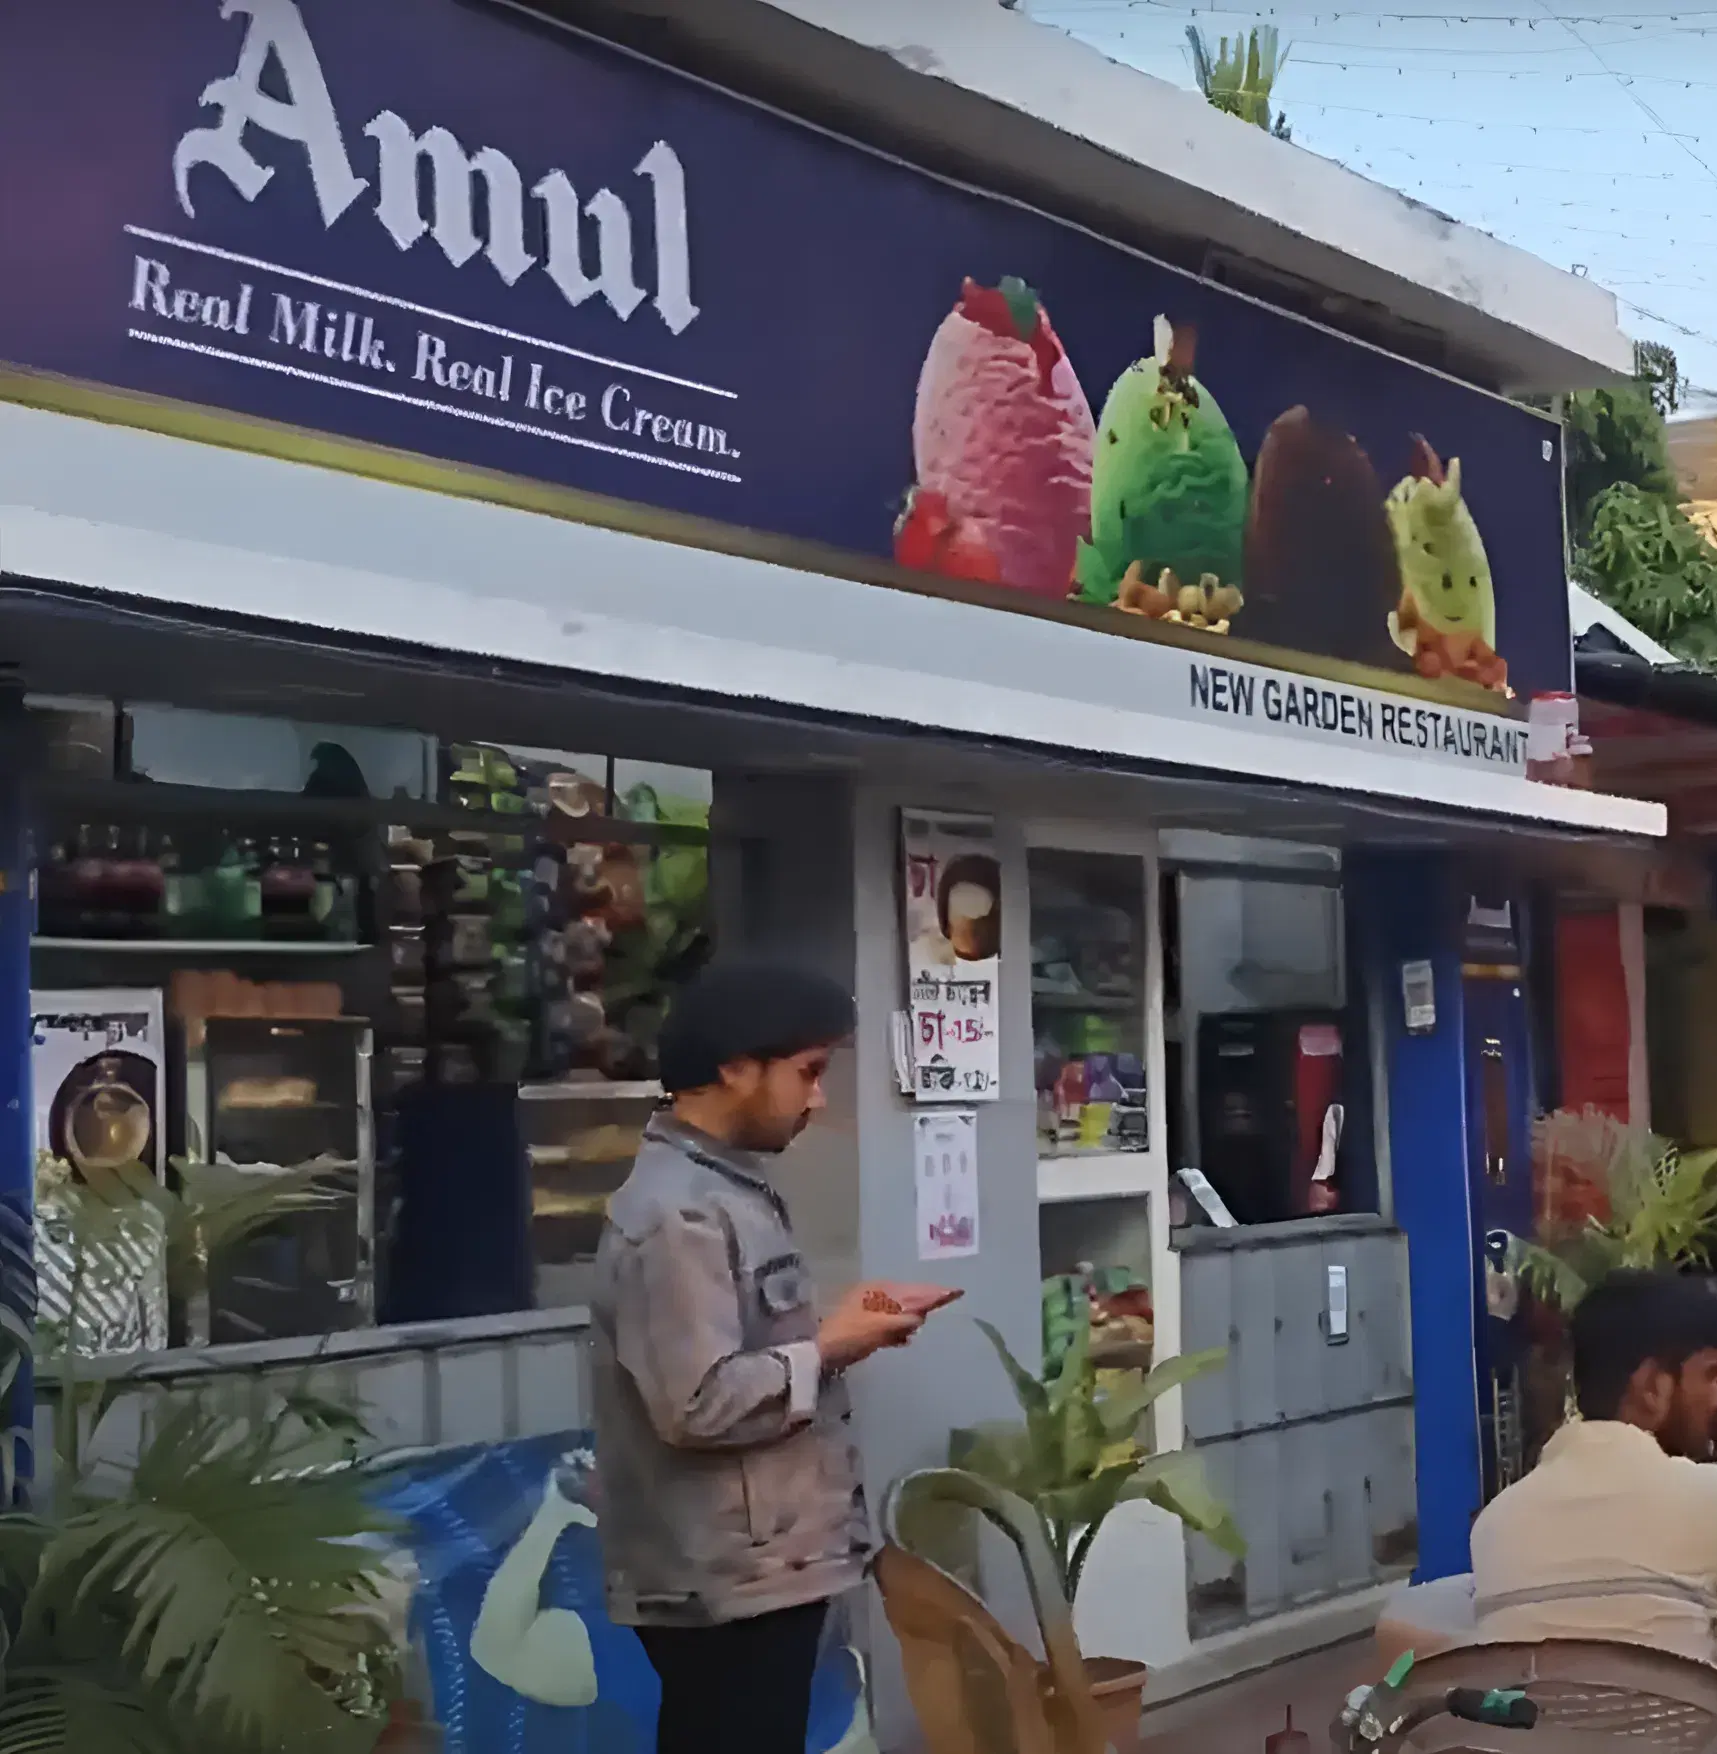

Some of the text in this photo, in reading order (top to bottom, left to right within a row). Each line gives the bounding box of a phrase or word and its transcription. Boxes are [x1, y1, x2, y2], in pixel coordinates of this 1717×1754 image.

[173, 0, 701, 335] Amul
[128, 254, 741, 460] Real Milk. Real Ice Cream.
[1189, 664, 1530, 765] NEW GARDEN RESTAURANT
